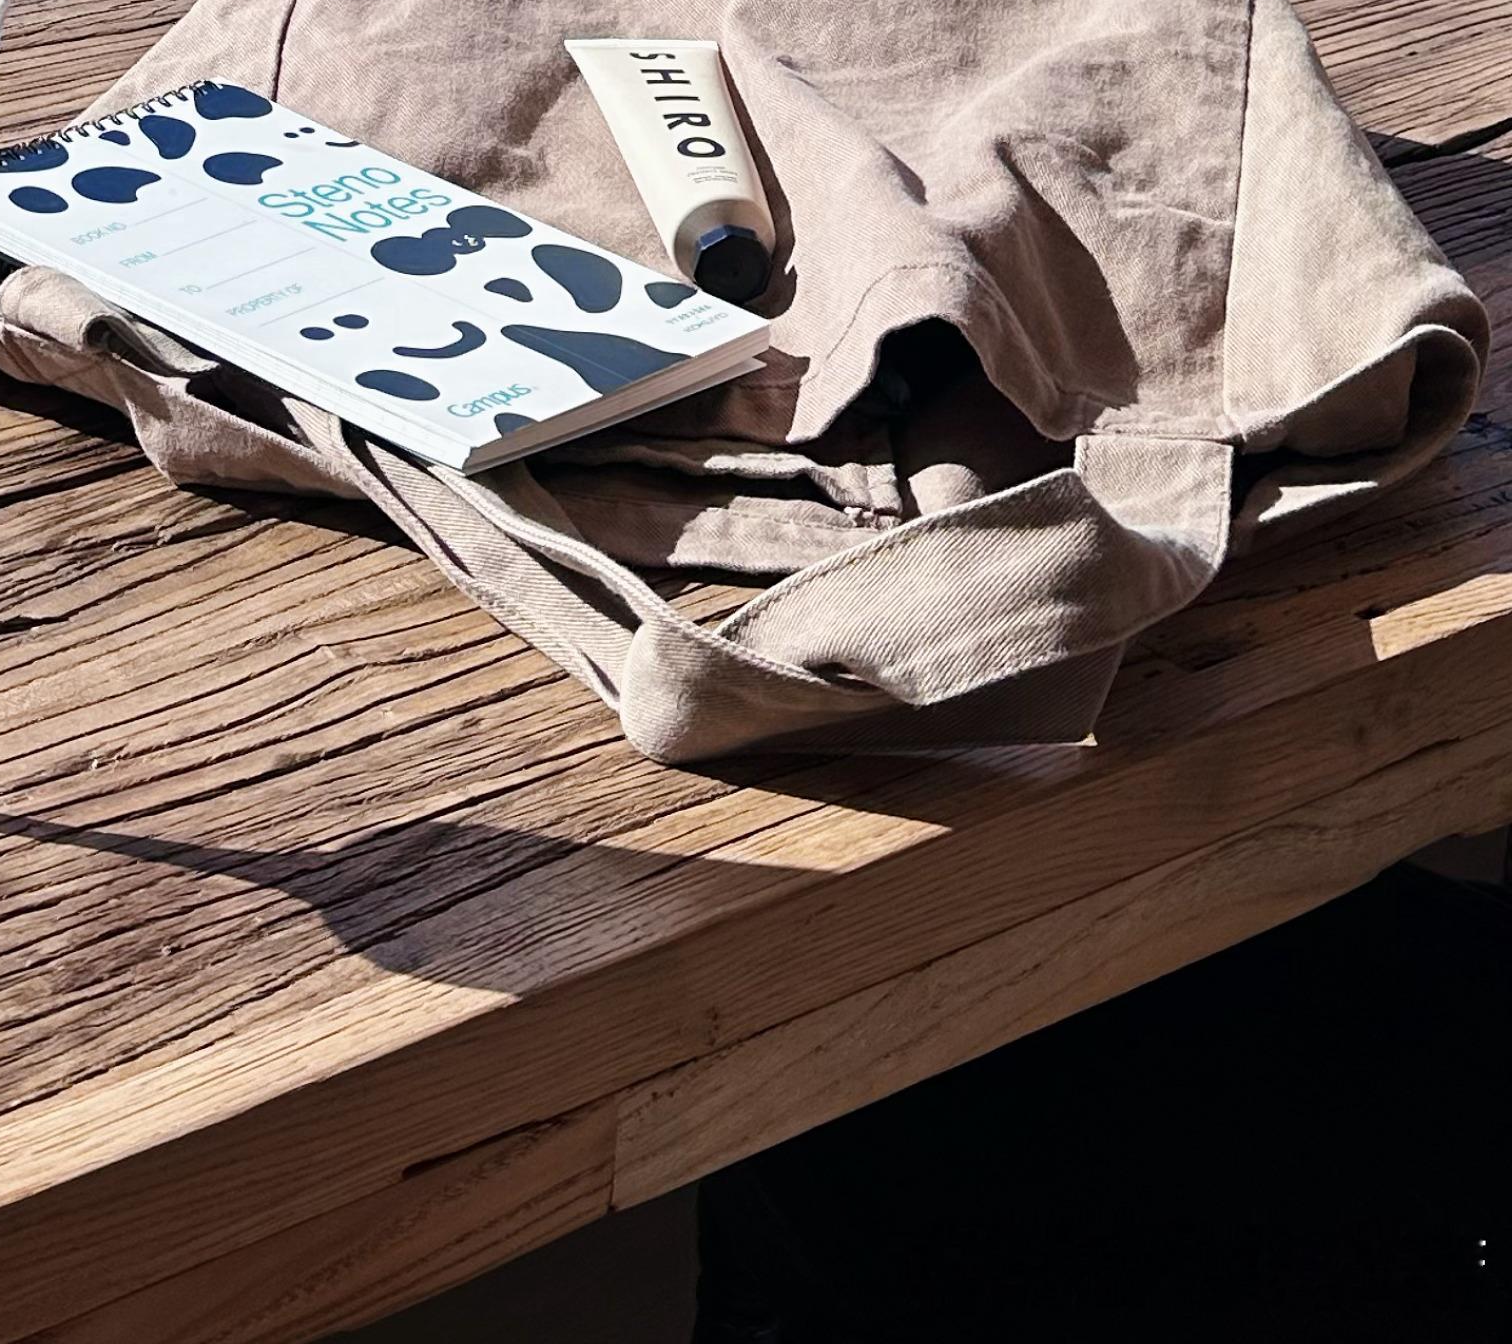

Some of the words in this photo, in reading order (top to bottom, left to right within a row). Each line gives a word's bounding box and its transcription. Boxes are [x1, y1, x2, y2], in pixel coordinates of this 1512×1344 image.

[629, 52, 726, 158] SHIRO
[257, 167, 401, 218] Steno
[301, 188, 452, 242] Notes
[119, 250, 159, 269] FROM
[446, 383, 532, 417] Campus
